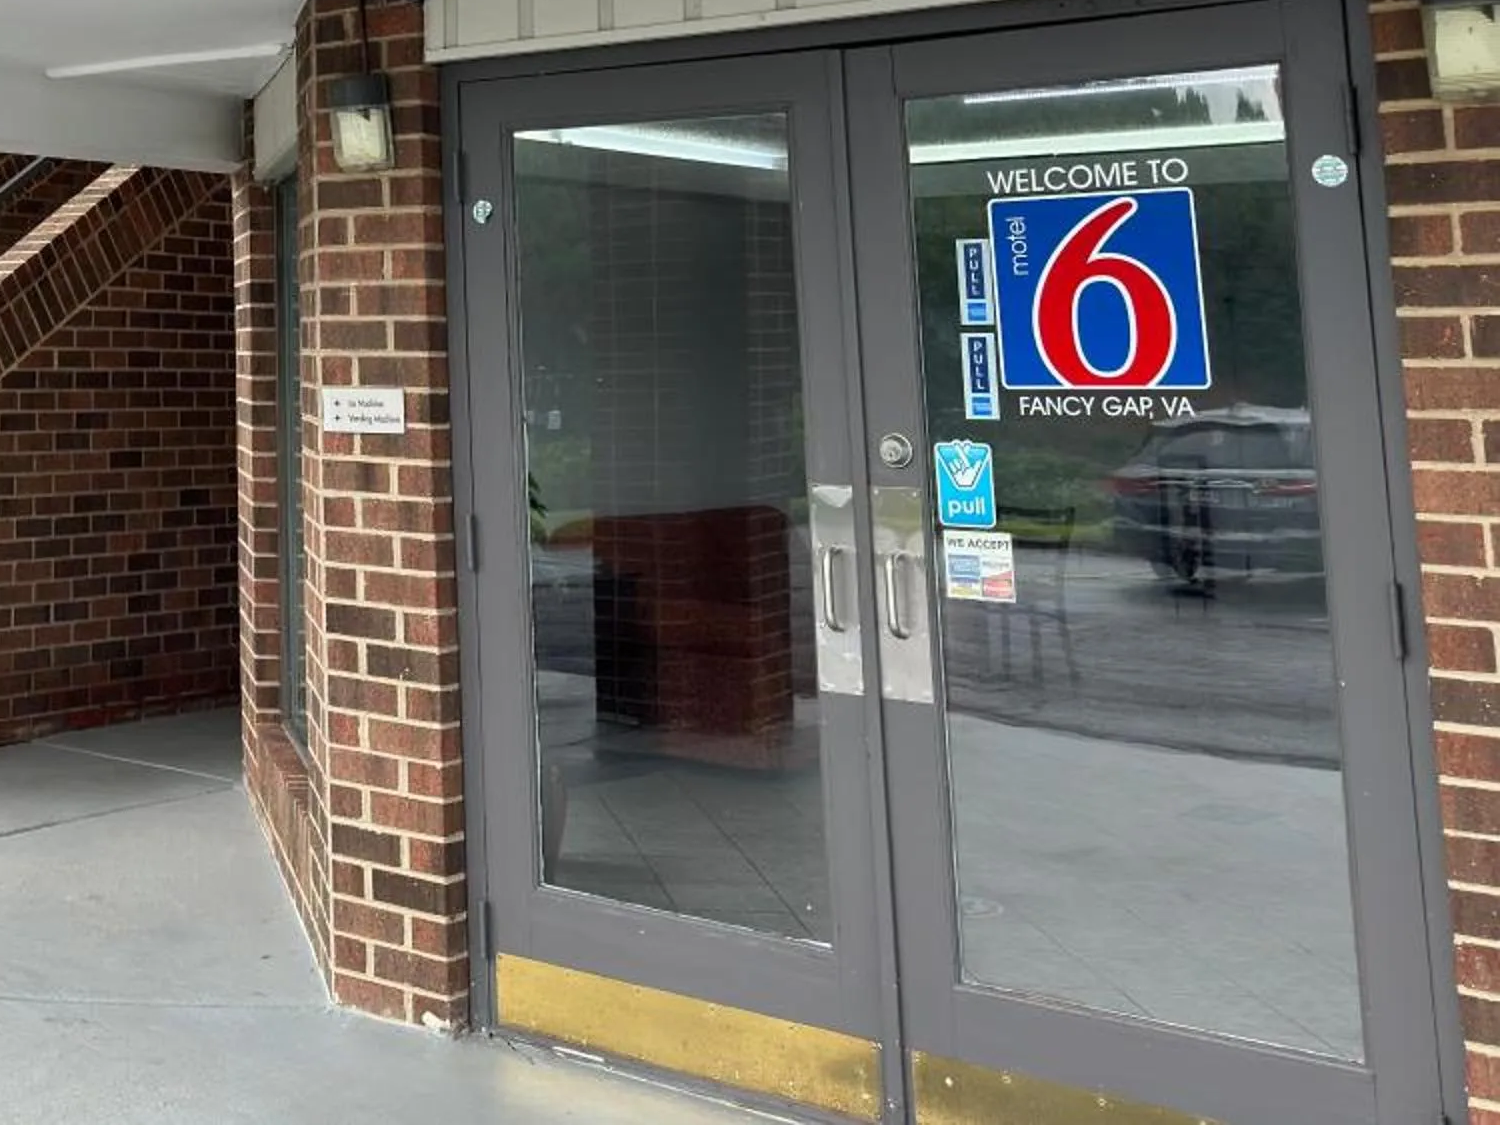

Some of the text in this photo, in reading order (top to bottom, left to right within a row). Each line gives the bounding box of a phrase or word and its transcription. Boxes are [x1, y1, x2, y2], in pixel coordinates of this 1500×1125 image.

[987, 158, 1189, 194] WELCOME TO
[1005, 216, 1029, 276] motel
[968, 247, 980, 296] PULL
[1032, 197, 1177, 389] 6
[972, 342, 985, 391] PULL
[1019, 397, 1196, 419] FANCY GAP, VA
[948, 497, 986, 517] pull
[947, 538, 1009, 551] WE ACCEPT
